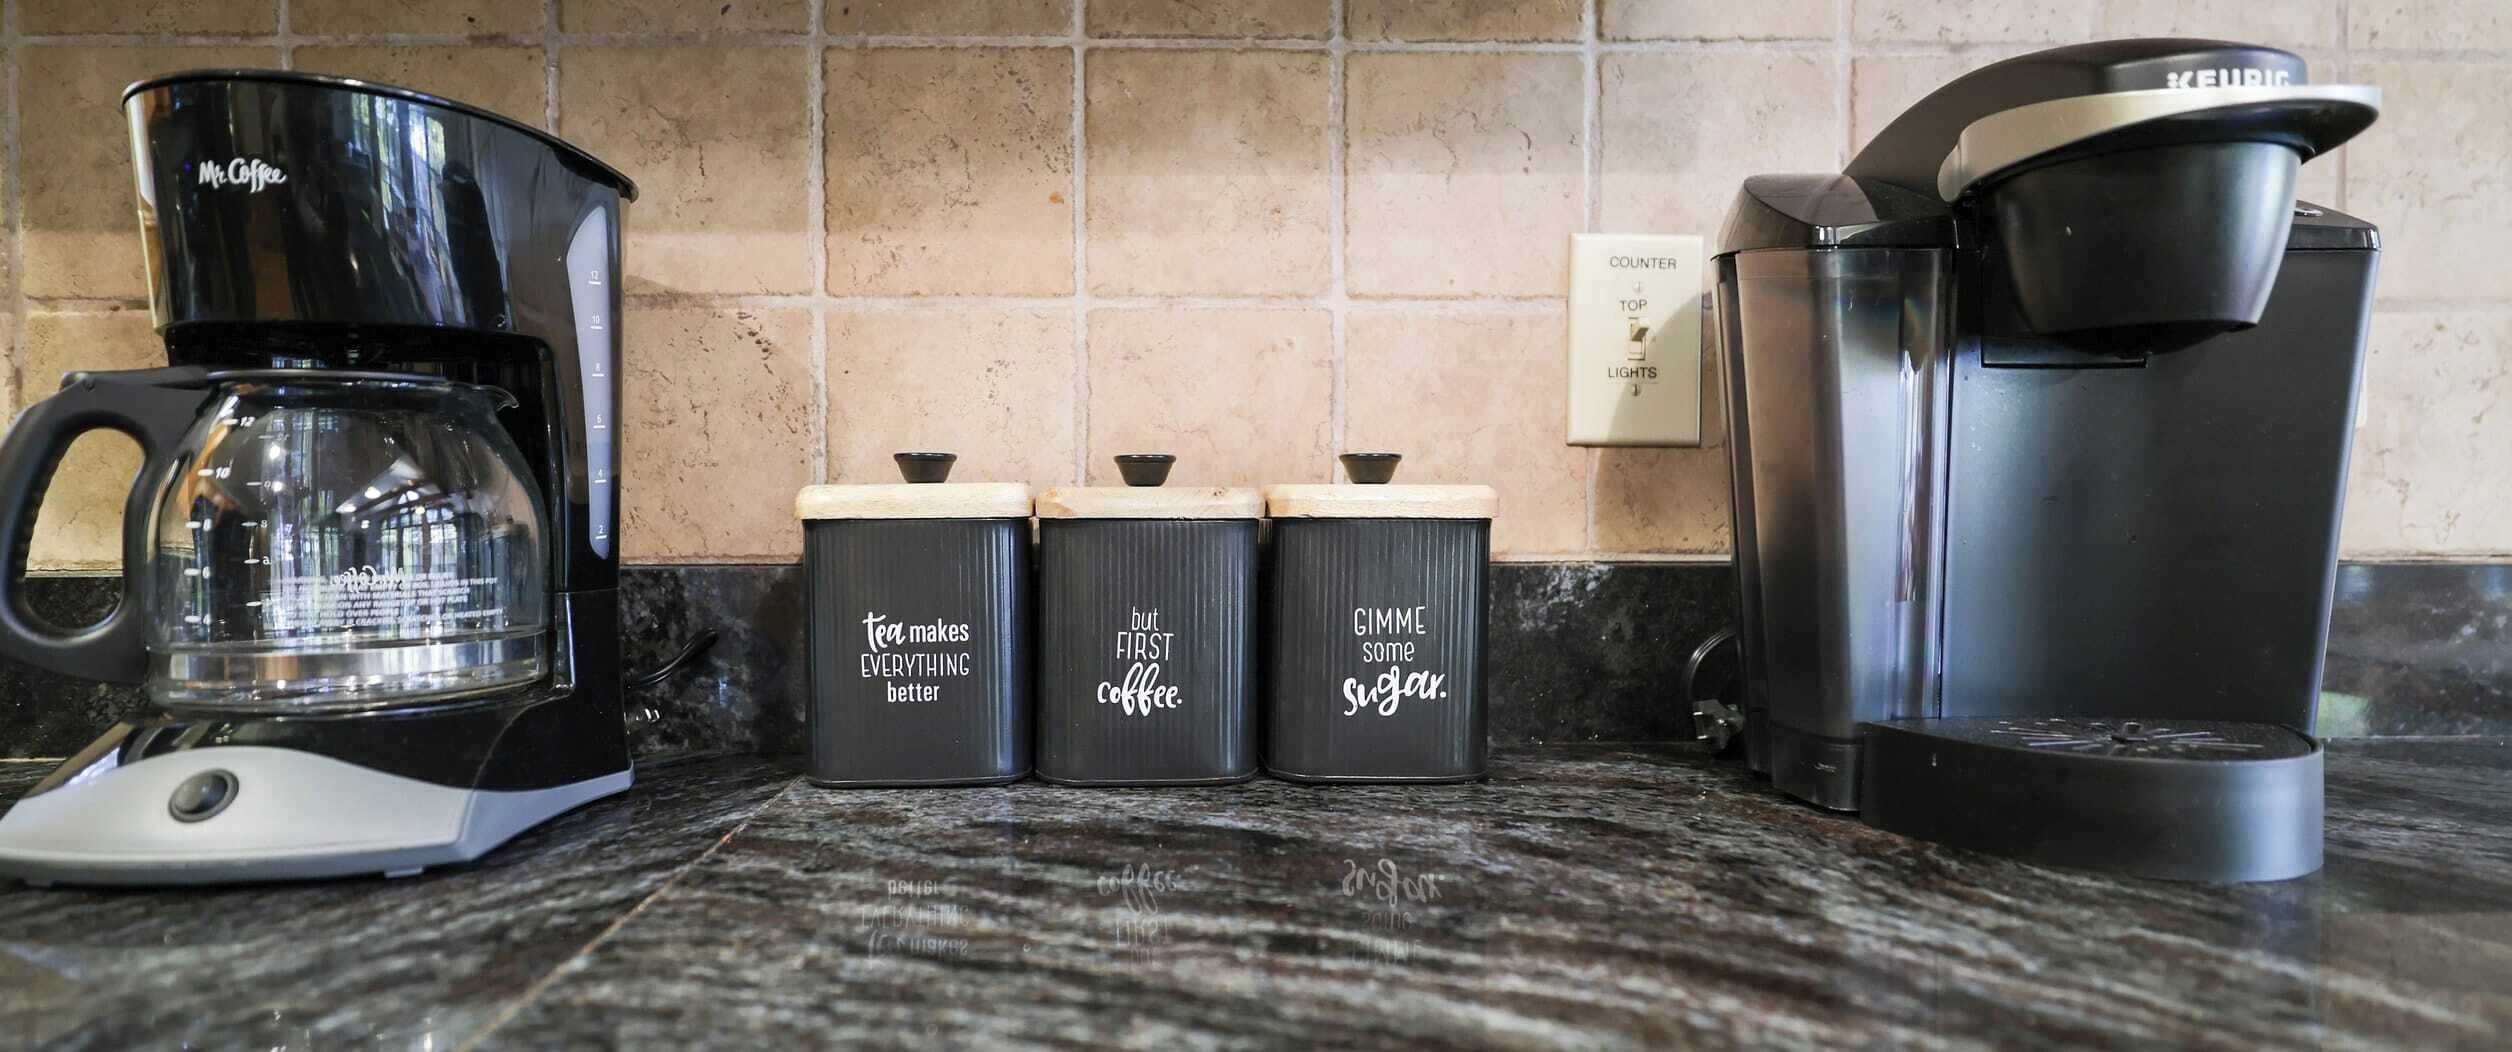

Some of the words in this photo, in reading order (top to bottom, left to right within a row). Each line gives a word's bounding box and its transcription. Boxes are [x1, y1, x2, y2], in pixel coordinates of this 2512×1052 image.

[227, 157, 287, 194] Coffee
[1609, 256, 1677, 270] COUNTER
[590, 270, 599, 280] 12
[1619, 299, 1648, 312] TOP
[592, 314, 600, 325] 10
[1608, 366, 1657, 378] LIGHTS
[240, 416, 256, 427] 12
[215, 466, 232, 480] 10
[345, 608, 369, 618] OVER
[352, 600, 371, 610] ANY
[1131, 605, 1159, 631] but
[1354, 605, 1426, 636] GIMME
[862, 611, 906, 653] tea
[909, 618, 970, 643] makes
[1116, 631, 1175, 661] FIRST
[1362, 641, 1415, 663] some
[860, 652, 970, 678] EVERYTHING
[887, 681, 940, 703] better
[1097, 661, 1183, 717] coffee.
[1343, 665, 1447, 716] sugar.
